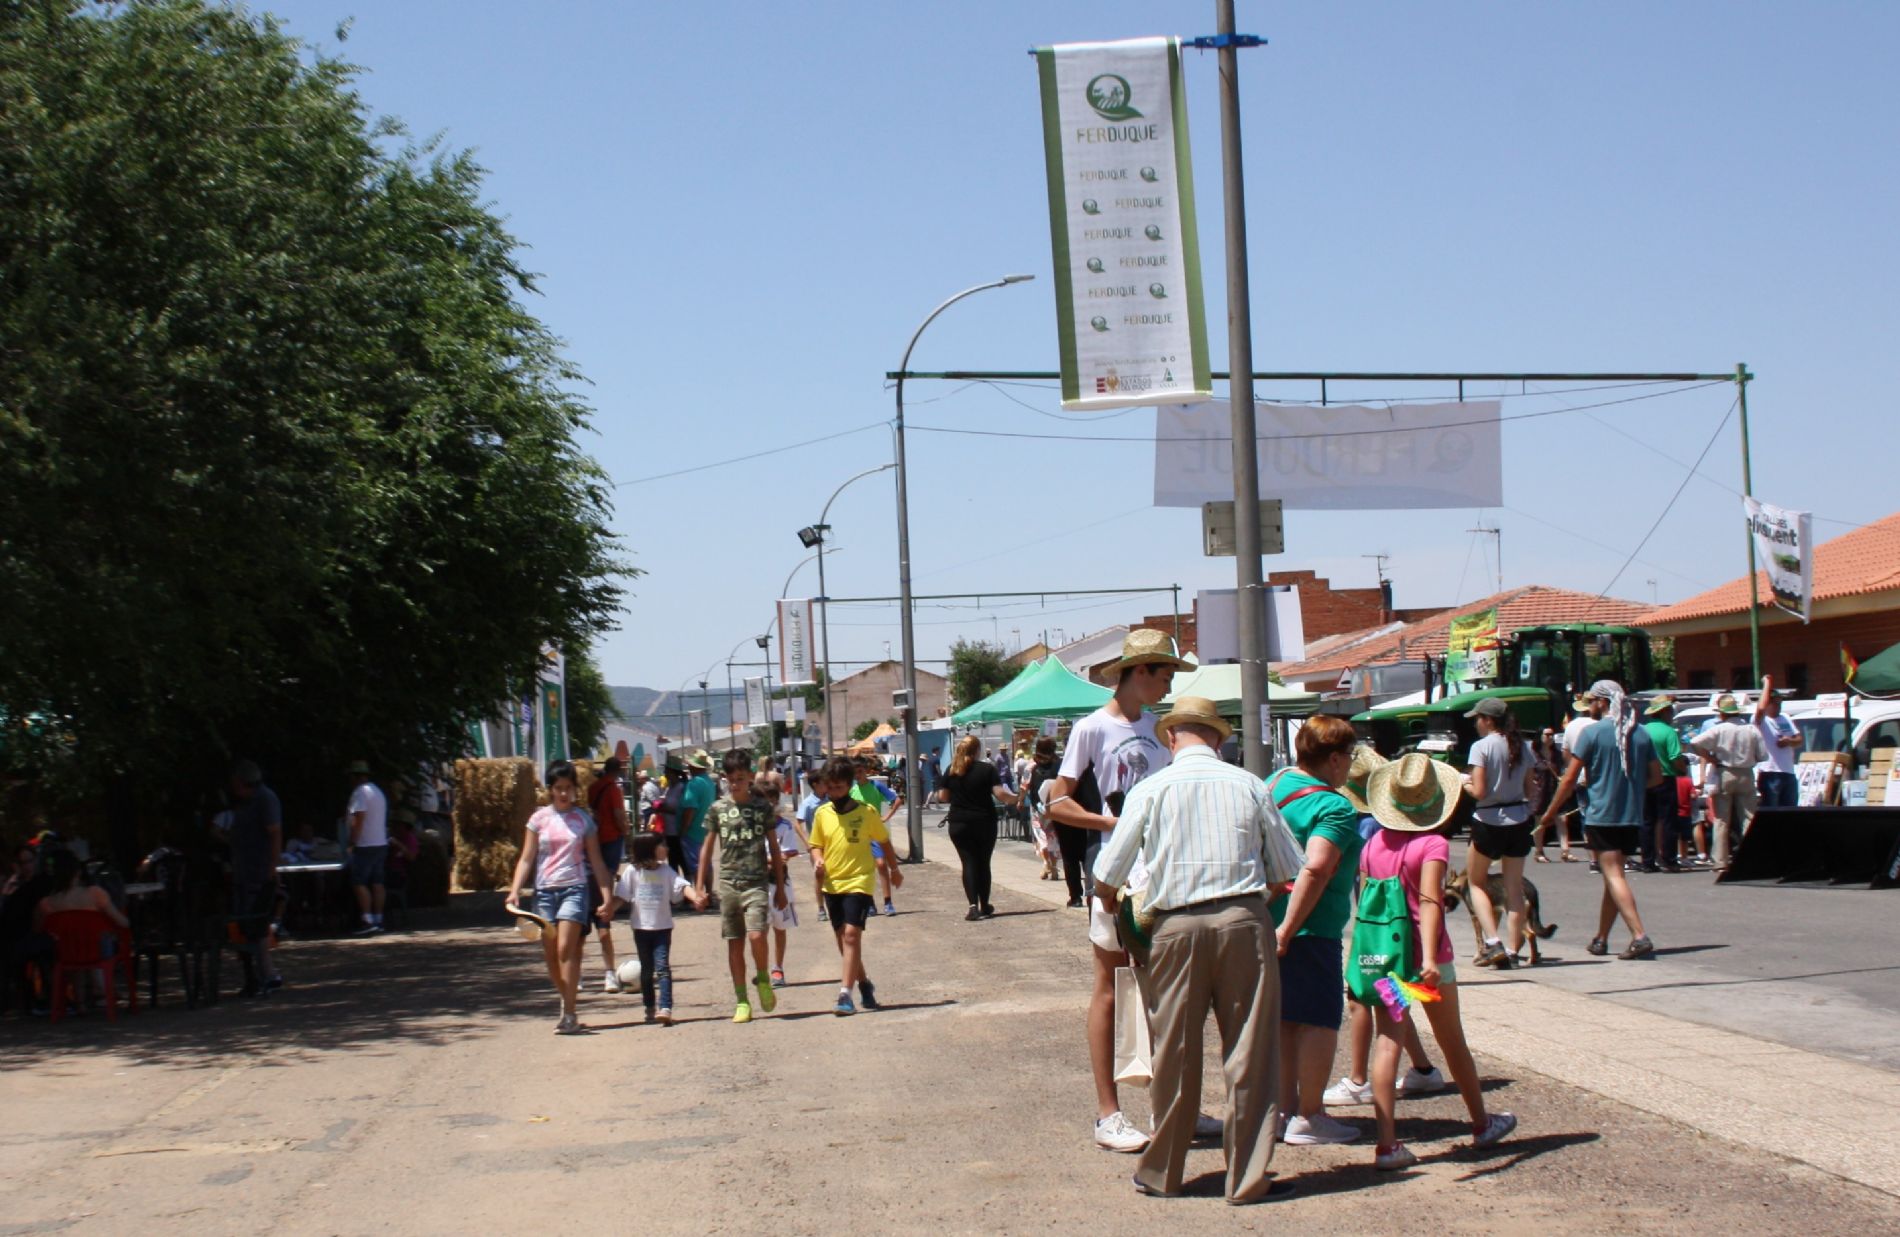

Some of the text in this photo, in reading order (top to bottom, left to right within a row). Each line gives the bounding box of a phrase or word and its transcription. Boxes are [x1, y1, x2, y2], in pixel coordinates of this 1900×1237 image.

[1076, 124, 1159, 144] FERDUQUE
[1080, 168, 1128, 181] FERDUQUE
[1115, 196, 1165, 209] FERDUQUE
[1084, 227, 1133, 239] FERDUQUE
[1120, 255, 1168, 267] FERDUQUE
[1088, 285, 1137, 298] FERDUQUE
[1123, 313, 1173, 325] FERDUQUE
[718, 808, 764, 825] ROCK
[720, 825, 764, 842] BAND
